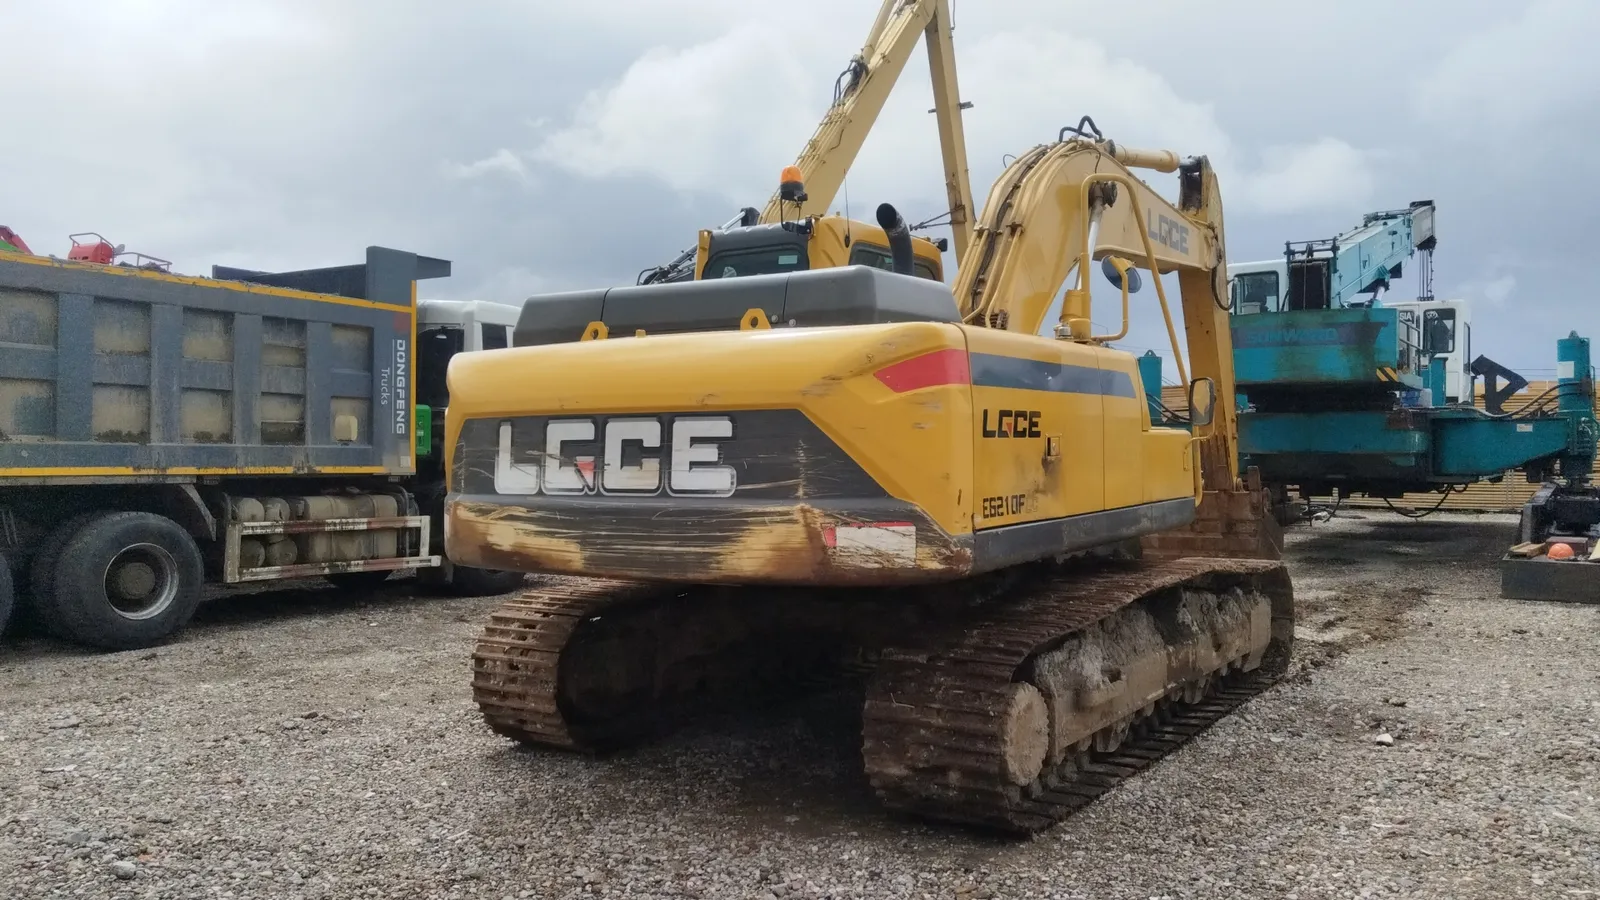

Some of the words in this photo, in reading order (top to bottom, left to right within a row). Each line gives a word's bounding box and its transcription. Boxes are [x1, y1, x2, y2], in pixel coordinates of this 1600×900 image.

[1247, 327, 1338, 344] SUNWD
[380, 367, 391, 405] Trucks
[396, 339, 406, 435] DONGFENG
